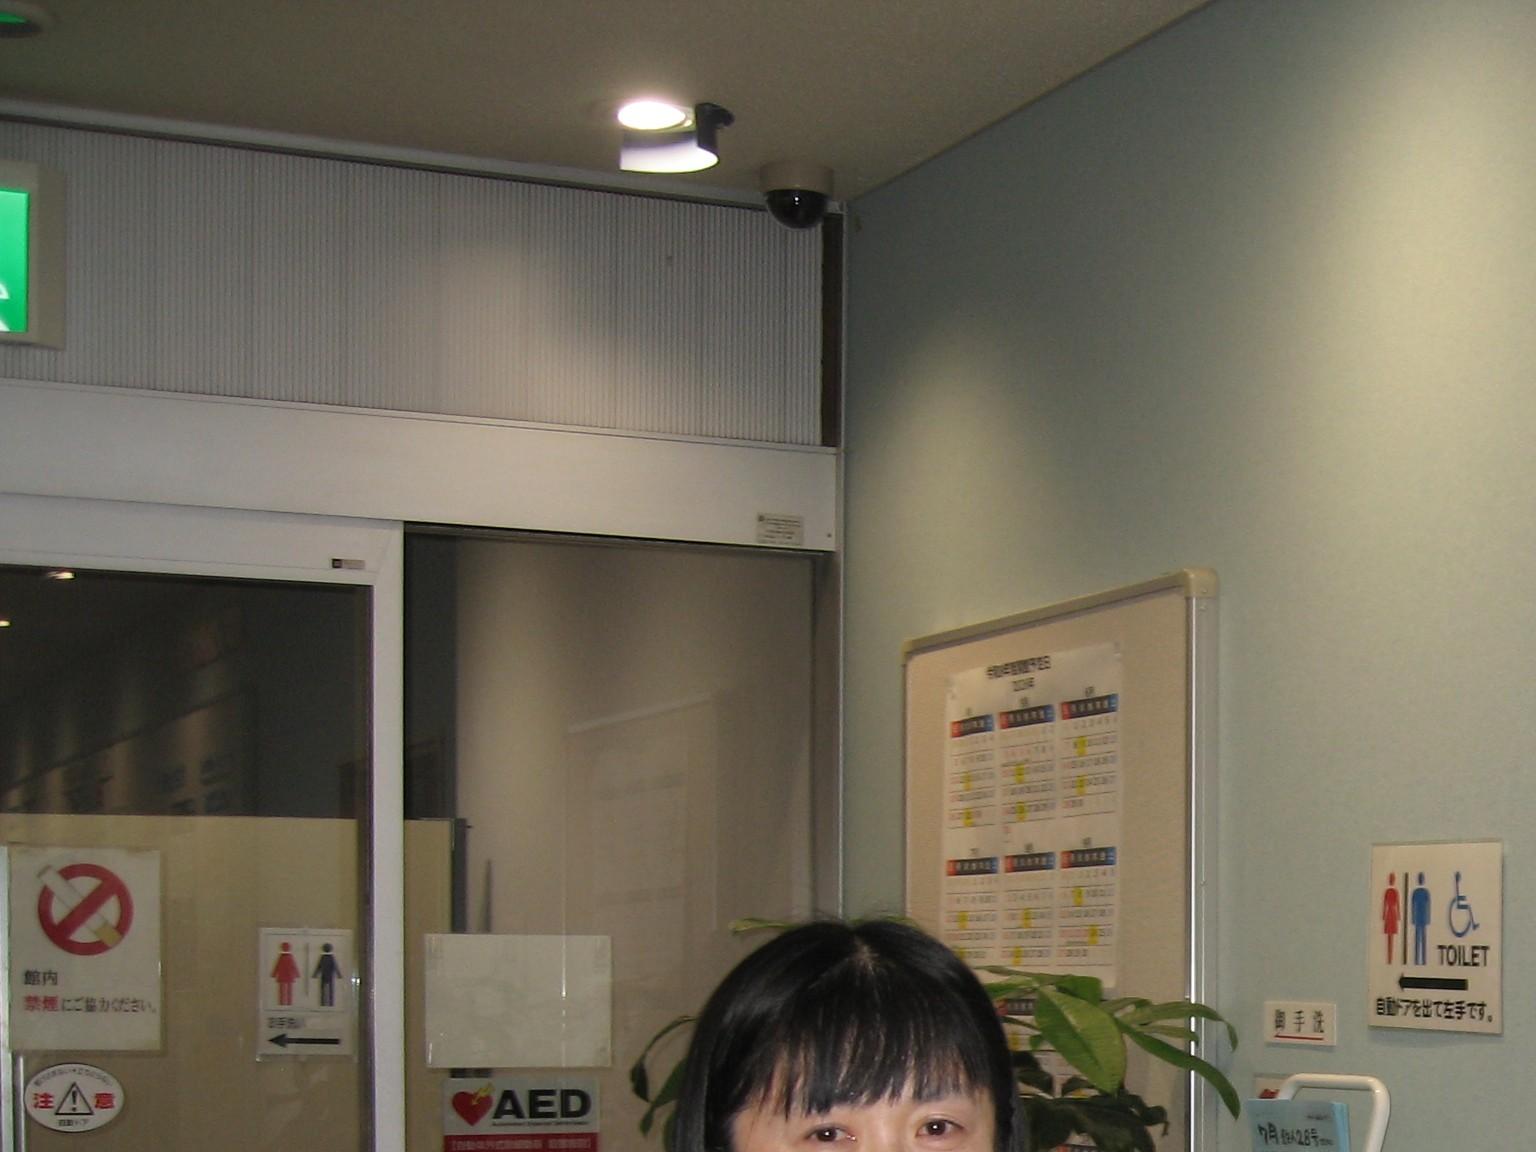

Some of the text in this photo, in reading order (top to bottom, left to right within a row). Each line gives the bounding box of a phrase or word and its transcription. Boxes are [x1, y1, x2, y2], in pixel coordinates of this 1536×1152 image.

[1437, 945, 1490, 967] TOILET
[23, 969, 58, 986] 館内
[23, 995, 157, 1013] 禁煙にご協力ください。
[1375, 997, 1493, 1023] 自動ドアを出て左手です。
[33, 1093, 115, 1109] 注 意
[492, 1089, 592, 1119] AED
